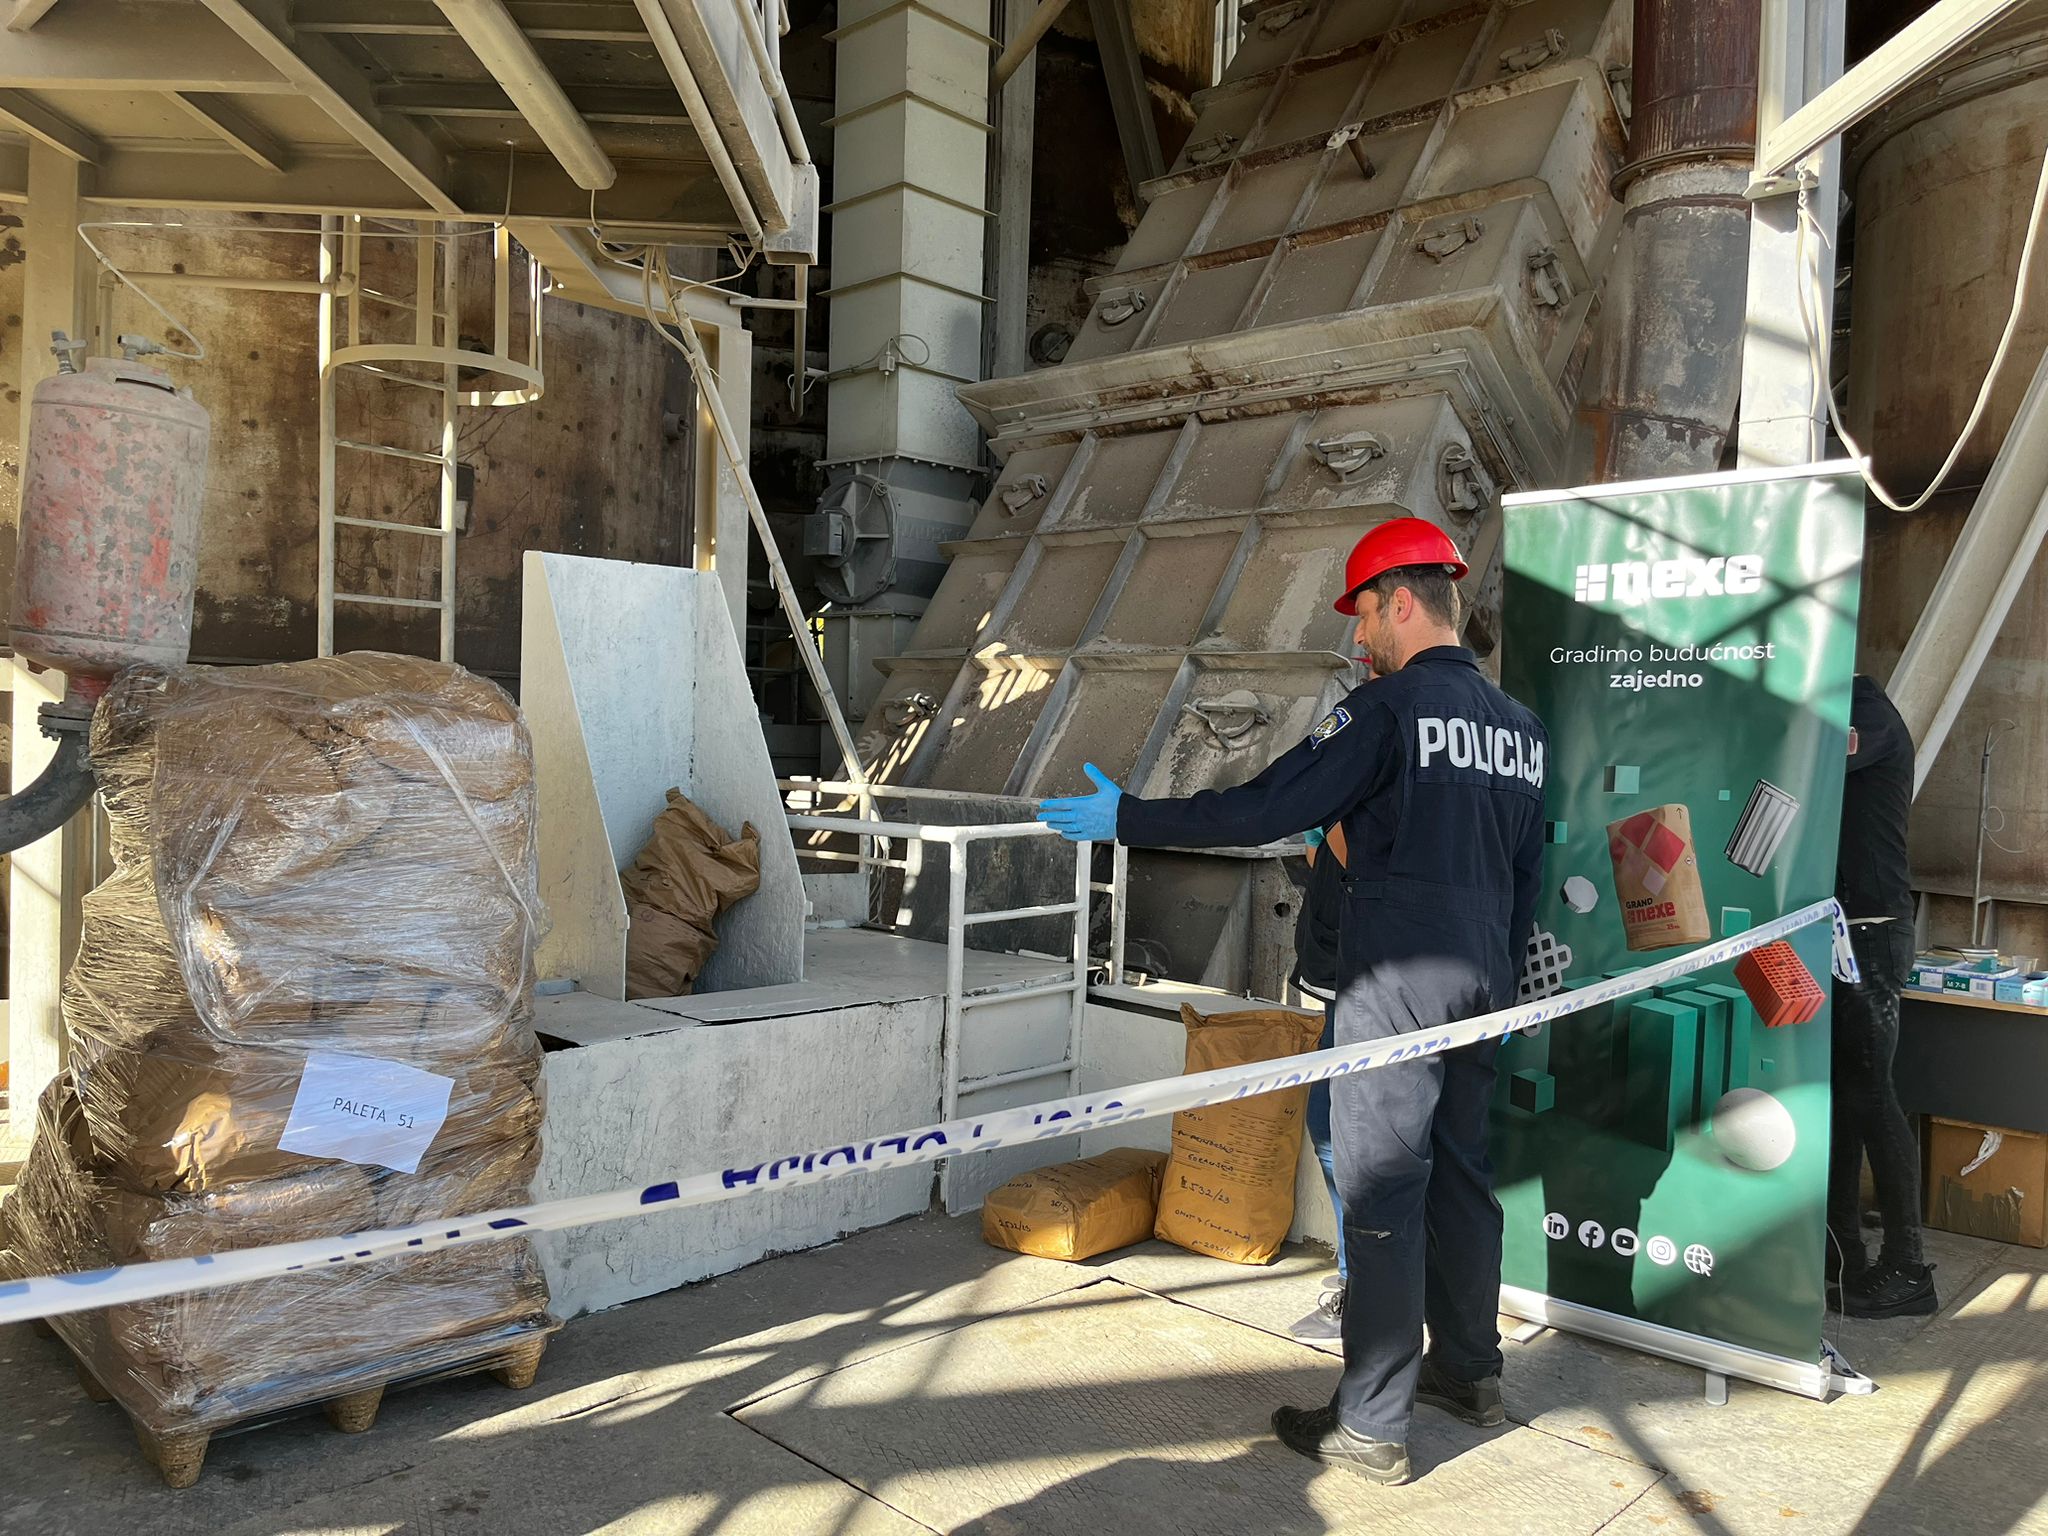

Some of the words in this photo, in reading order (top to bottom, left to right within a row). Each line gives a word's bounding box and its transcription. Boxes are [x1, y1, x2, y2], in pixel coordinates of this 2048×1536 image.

[1611, 554, 1764, 601] nexe
[1549, 645, 1643, 665] Gradimo
[1648, 641, 1776, 662] budućnost
[1609, 668, 1704, 692] zajedno
[1417, 717, 1544, 789] POLICIJA
[1625, 897, 1653, 909] GRAND
[1635, 901, 1676, 923] nexe
[333, 1097, 387, 1123] PALETA
[397, 1113, 414, 1129] 51
